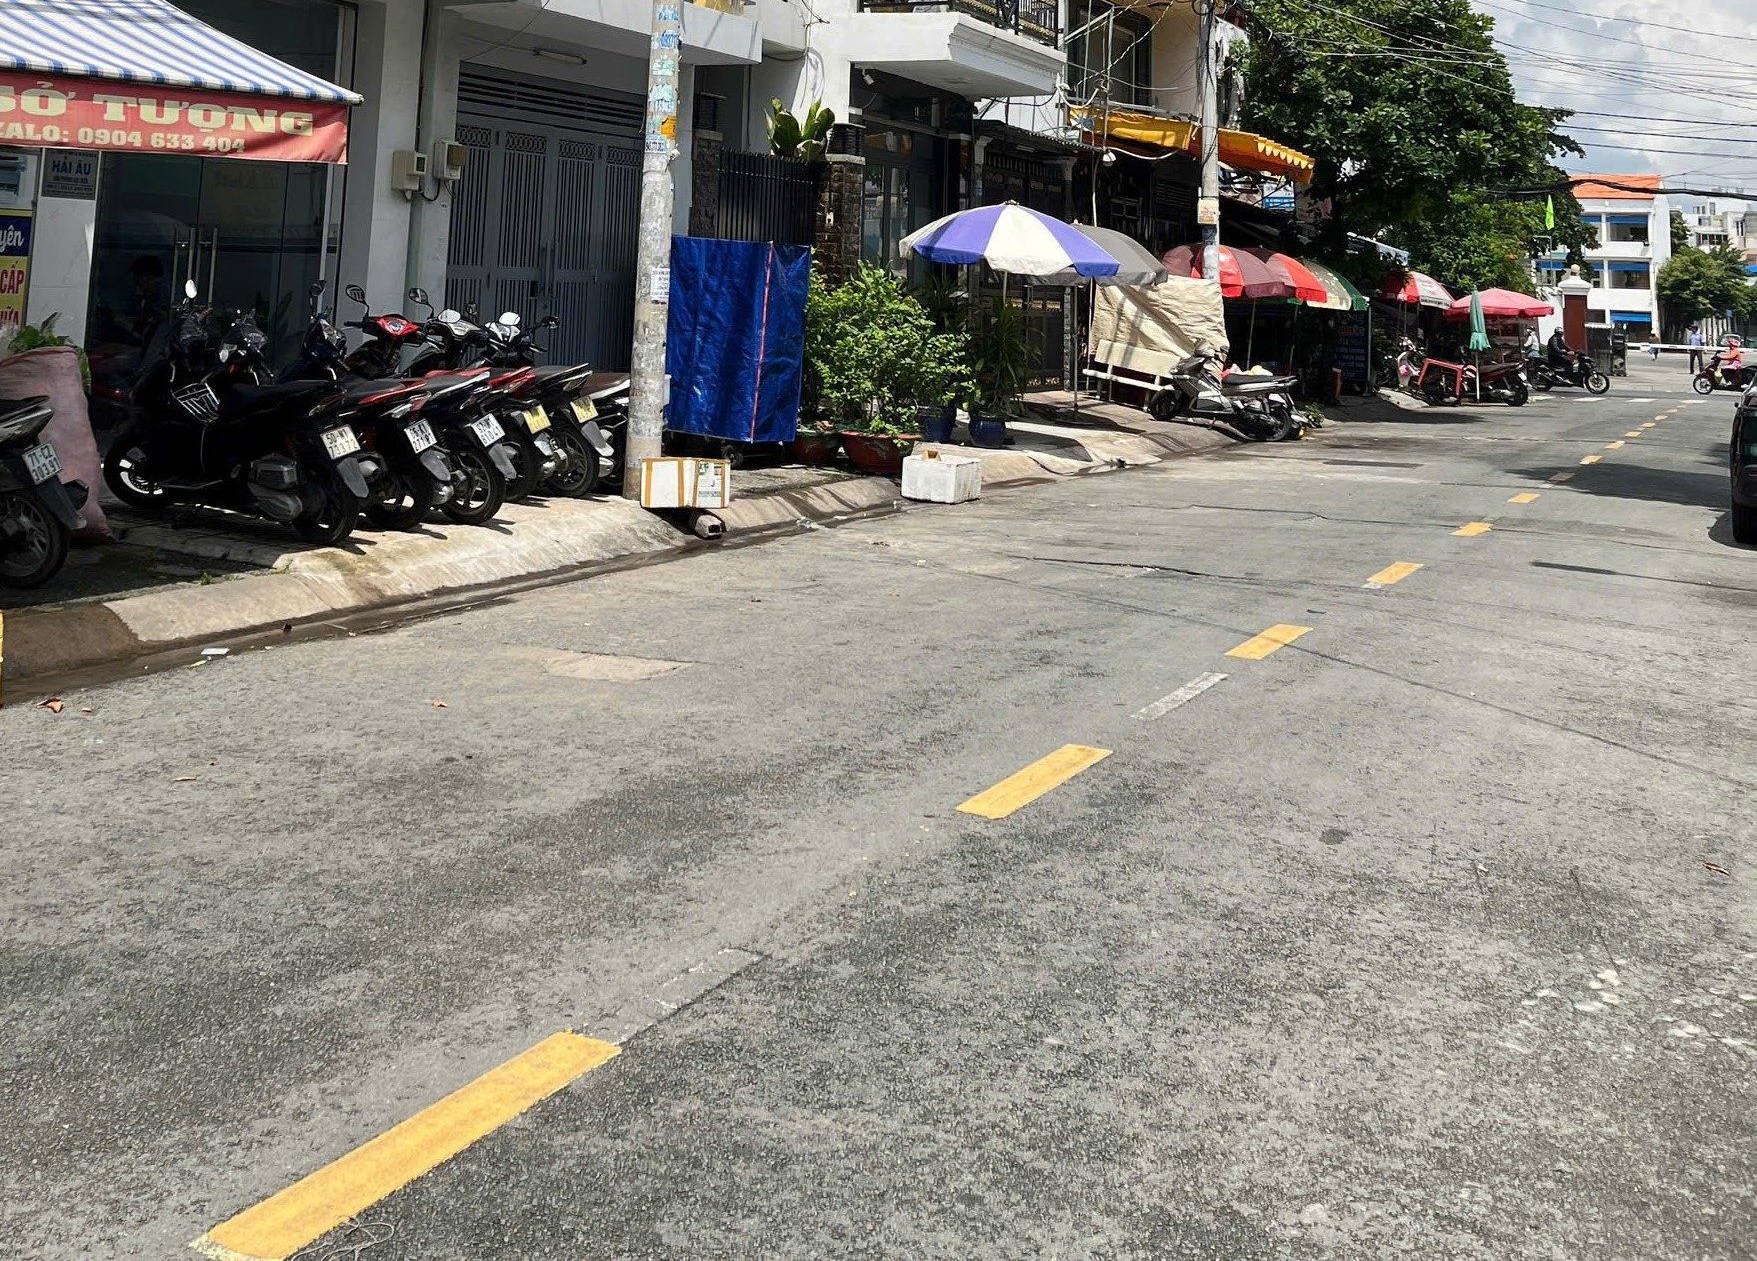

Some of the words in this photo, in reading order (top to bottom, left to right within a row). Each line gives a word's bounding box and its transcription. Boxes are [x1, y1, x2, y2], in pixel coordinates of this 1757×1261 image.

[92, 93, 313, 137] TƯỢNG
[77, 127, 143, 148] 0904
[150, 132, 195, 150] 633
[202, 137, 245, 154] 404
[0, 260, 25, 294] CẤP
[0, 305, 19, 326] ỮA
